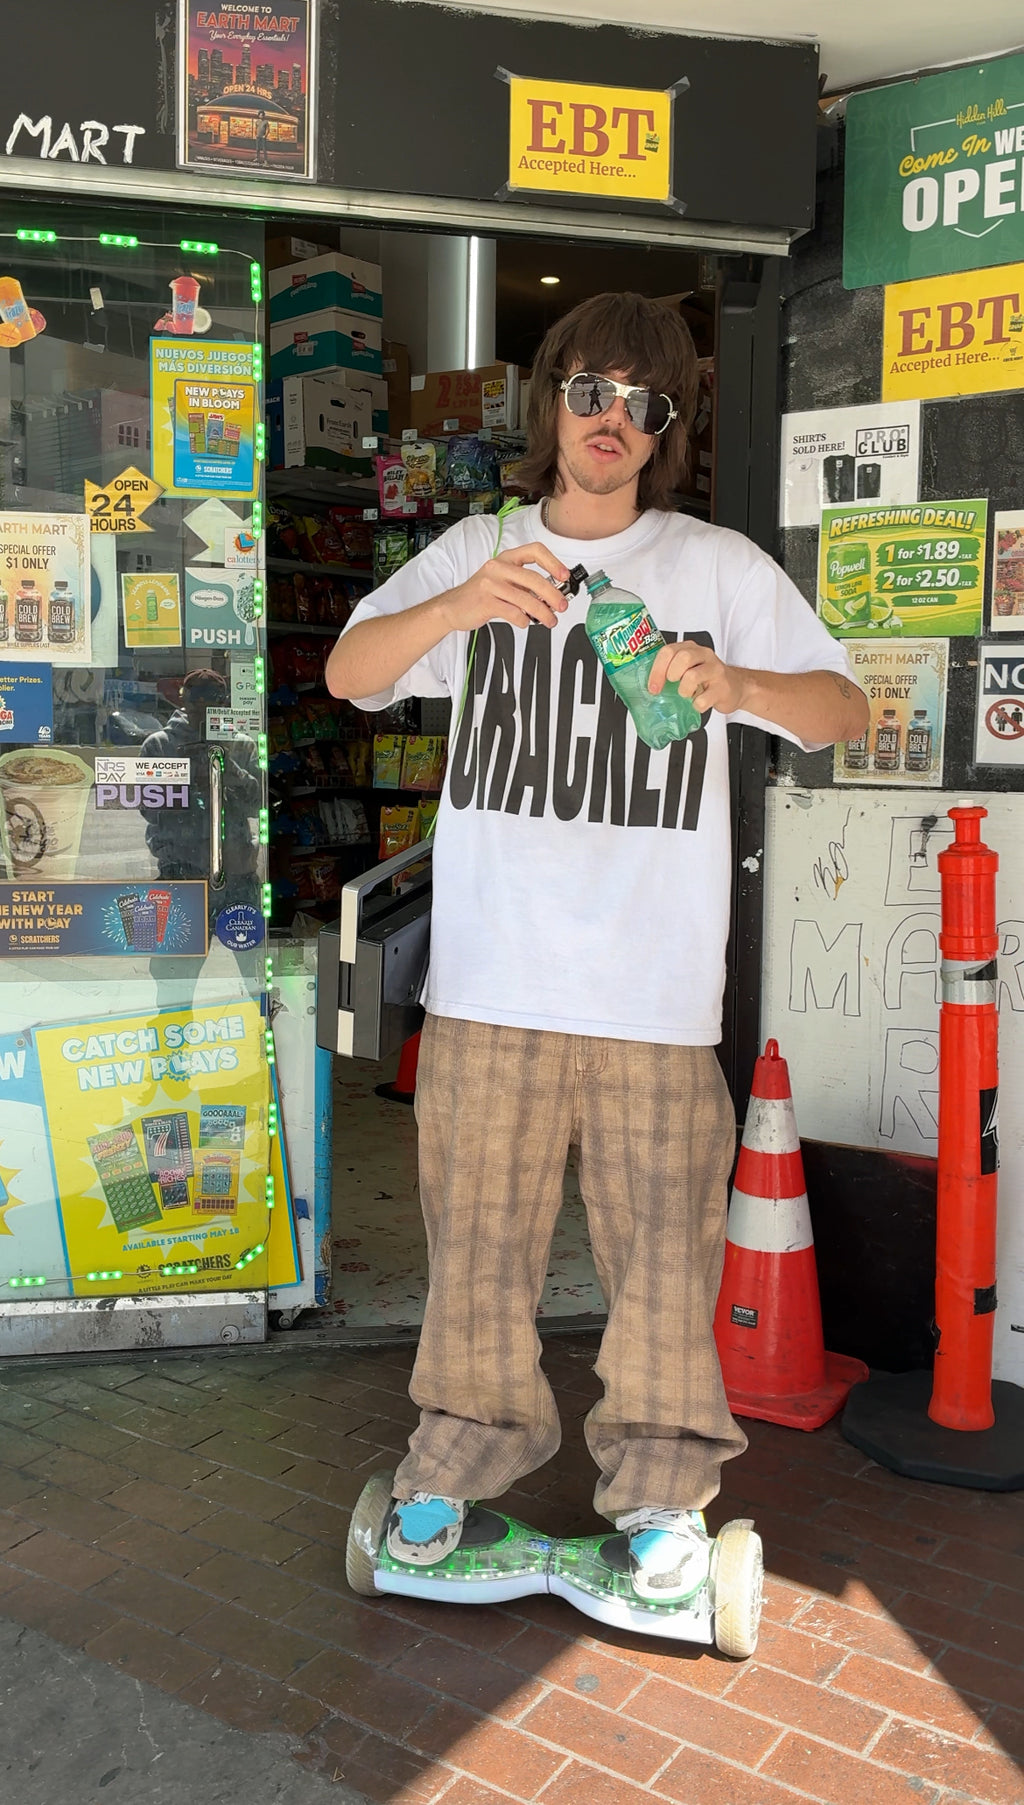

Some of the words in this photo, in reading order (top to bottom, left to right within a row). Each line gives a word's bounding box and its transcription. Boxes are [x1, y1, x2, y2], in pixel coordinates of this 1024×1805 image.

[221, 4, 259, 13] WELCOME
[261, 6, 272, 14] TO
[196, 11, 250, 30] EARTH
[254, 15, 300, 33] MART
[209, 30, 226, 41] Your
[227, 31, 256, 42] Everyday
[224, 84, 244, 94] OPEN
[245, 84, 255, 93] 24
[256, 87, 272, 100] HRS
[987, 98, 1008, 122] Hills
[527, 99, 654, 160] EBT
[5, 112, 146, 164] MART
[899, 148, 959, 177] Come
[962, 134, 991, 157] In
[518, 156, 585, 175] Accepted
[589, 162, 636, 178] Here...
[902, 157, 1024, 232] OPE
[897, 293, 1020, 357] EBT
[156, 349, 204, 361] NUEVOS
[207, 351, 253, 363] JUEGOS
[159, 360, 185, 373] MÁS
[187, 362, 252, 376] DIVERSIÓN
[890, 354, 951, 375] Accepted
[955, 352, 1000, 366] Here...
[185, 386, 209, 397] NEW
[188, 398, 200, 408] IN
[202, 399, 241, 410] BLOOM
[793, 433, 827, 445] SHIRTS
[864, 429, 901, 443] PRO
[793, 444, 816, 455] SOLD
[818, 441, 845, 453] HERE!
[858, 438, 906, 455] CLUB
[114, 480, 149, 491] OPEN
[92, 494, 135, 517] 24
[90, 518, 136, 531] HOURS
[829, 508, 921, 538] REFRESHING
[922, 509, 976, 531] DEAL!
[32, 524, 68, 536] MART
[32, 545, 56, 556] OFFER
[886, 544, 895, 563] 1
[898, 548, 913, 559] for
[917, 540, 960, 561] $1.89
[6, 557, 18, 569] $1
[22, 558, 49, 570] ONLY
[882, 572, 895, 590] 2
[896, 575, 913, 587] for
[916, 568, 960, 587] $2.50
[18, 604, 38, 614] COLD
[52, 606, 71, 615] COLD
[18, 614, 38, 623] BREW
[52, 615, 71, 624] BREW
[191, 628, 240, 645] PUSH
[854, 654, 892, 665] EARTH
[896, 653, 930, 665] MART
[20, 676, 43, 684] Prizes.
[864, 674, 893, 685] SPECIAL
[895, 674, 918, 685] OFFER
[870, 688, 882, 699] $1
[884, 688, 910, 699] ONLY
[879, 734, 897, 743] COLD
[910, 734, 928, 744] COLD
[879, 742, 897, 751] BREW
[910, 743, 928, 753] BREW
[97, 762, 126, 772] NRS
[136, 762, 150, 770] WE
[152, 762, 188, 770] ACCEPT
[97, 773, 126, 782] PAY
[96, 785, 189, 808] PUSH
[12, 890, 55, 902] START
[0, 904, 9, 916] E
[12, 904, 44, 916] NEW
[47, 904, 83, 916] YEAR
[226, 904, 248, 915] CLEARLY
[0, 918, 34, 930] WITH
[20, 935, 60, 944] SCRATCHERS
[227, 940, 238, 948] OUR
[238, 940, 257, 948] WATER
[62, 1027, 159, 1062] CATCH
[164, 1015, 245, 1049] SOME
[78, 1059, 145, 1092] NEW
[122, 1240, 166, 1251] AVAILABLE
[167, 1232, 208, 1245] STARTING
[210, 1230, 229, 1239] MAY
